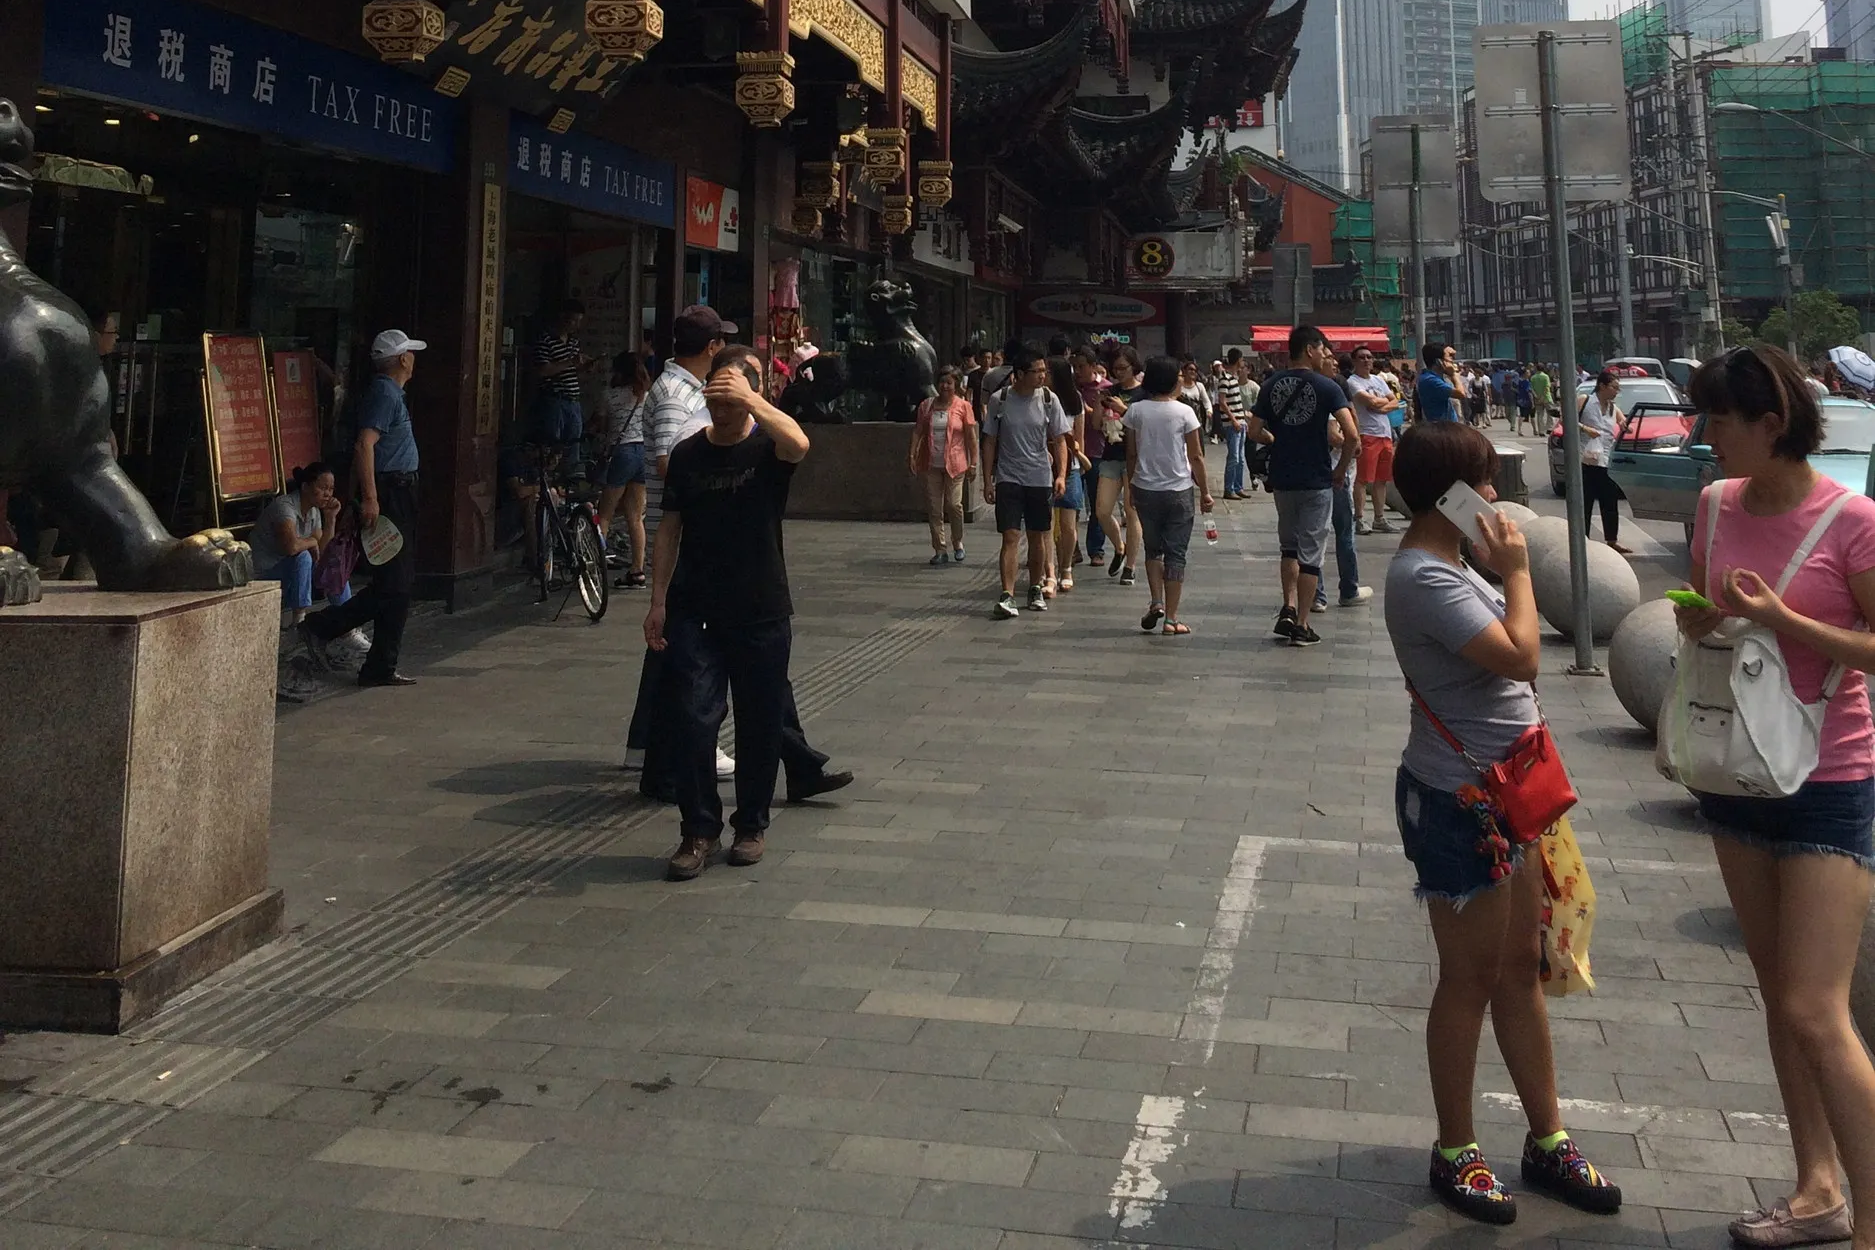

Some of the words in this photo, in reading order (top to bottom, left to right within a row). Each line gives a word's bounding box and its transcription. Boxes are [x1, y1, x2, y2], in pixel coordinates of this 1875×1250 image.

[308, 74, 360, 126] TAX
[373, 93, 433, 144] FREE
[604, 165, 630, 198] TAX
[634, 174, 663, 207] FREE
[1140, 240, 1163, 266] 8
